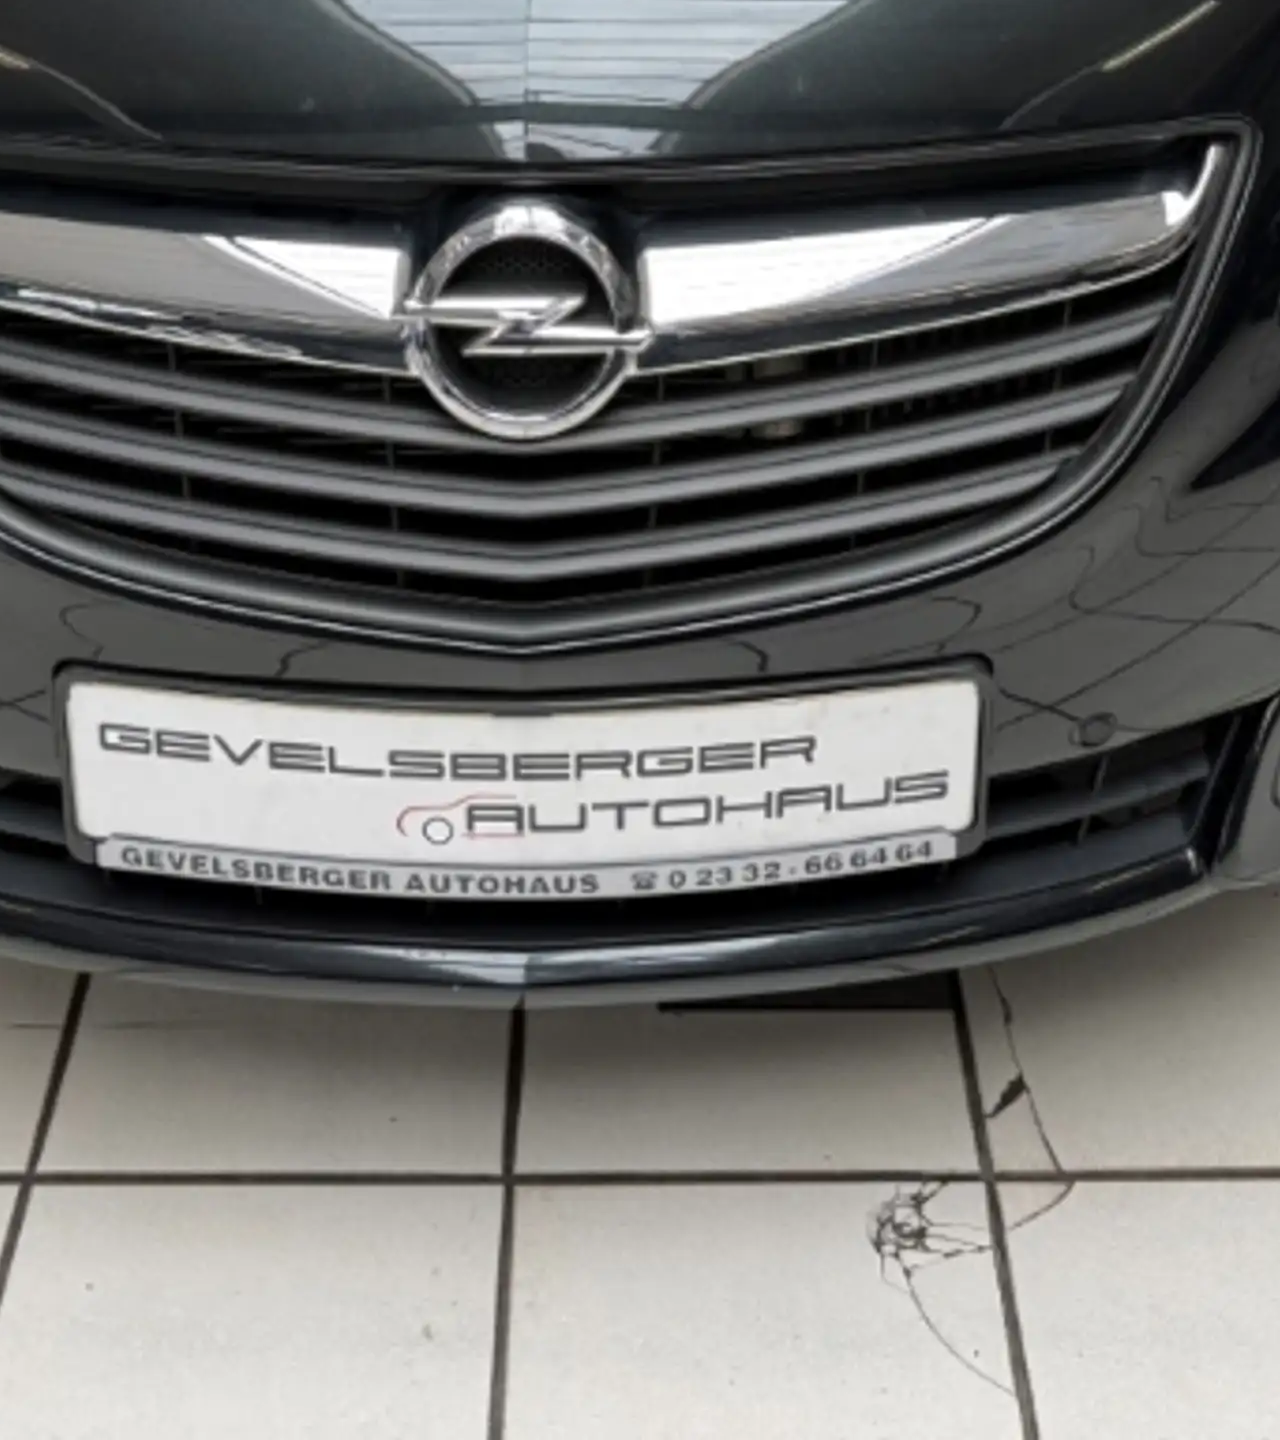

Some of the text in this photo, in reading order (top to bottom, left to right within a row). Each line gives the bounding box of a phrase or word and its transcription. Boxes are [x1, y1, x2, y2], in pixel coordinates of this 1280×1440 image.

[98, 722, 817, 782] GEVELSBERGER
[466, 769, 949, 838] AUTOHAUS
[121, 845, 392, 892] GEVELSBERGER
[404, 873, 600, 895] AUTOHAUS
